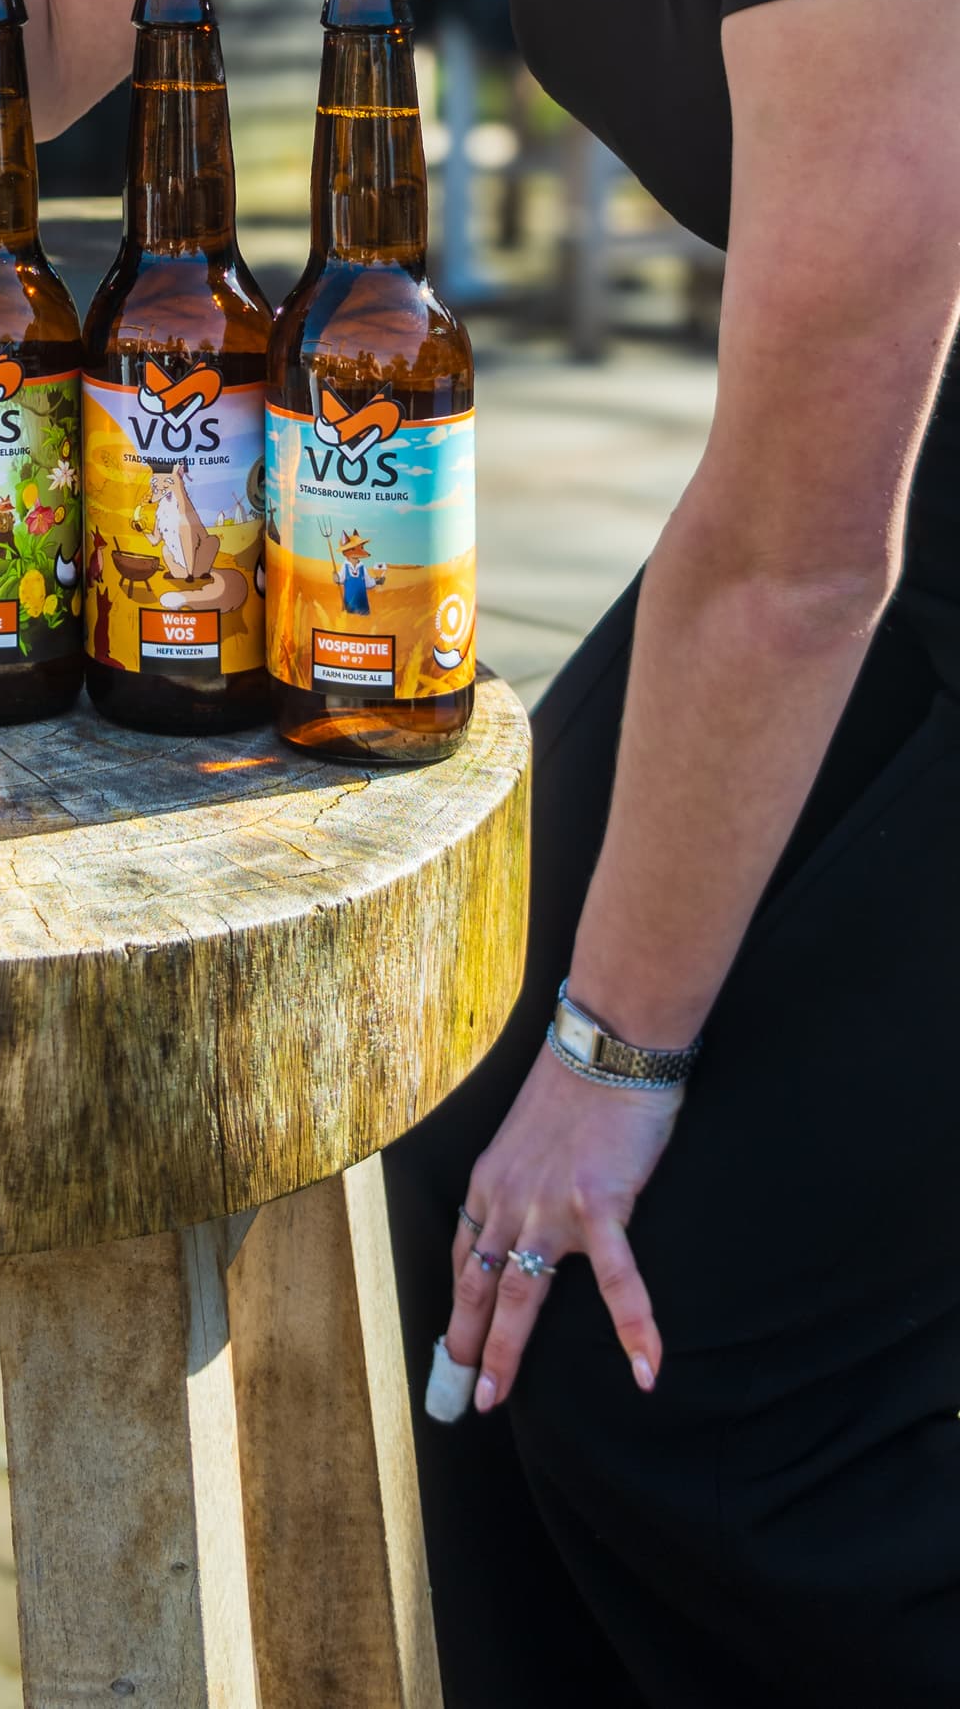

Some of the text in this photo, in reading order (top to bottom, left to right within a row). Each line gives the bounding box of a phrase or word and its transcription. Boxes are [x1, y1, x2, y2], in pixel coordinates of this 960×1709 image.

[128, 416, 221, 452] VOS
[0, 447, 30, 456] ELBURG
[199, 456, 230, 465] ELBURG
[304, 446, 398, 488] VOS
[300, 485, 409, 501] STADSBROUWERIJ ELBURG
[162, 614, 196, 626] Weize
[164, 628, 194, 640] VOS
[156, 647, 203, 656] HEFE WEIZEN
[317, 637, 388, 655] VOSPEDITIE
[322, 670, 382, 682] FARM HOUSE ALE
